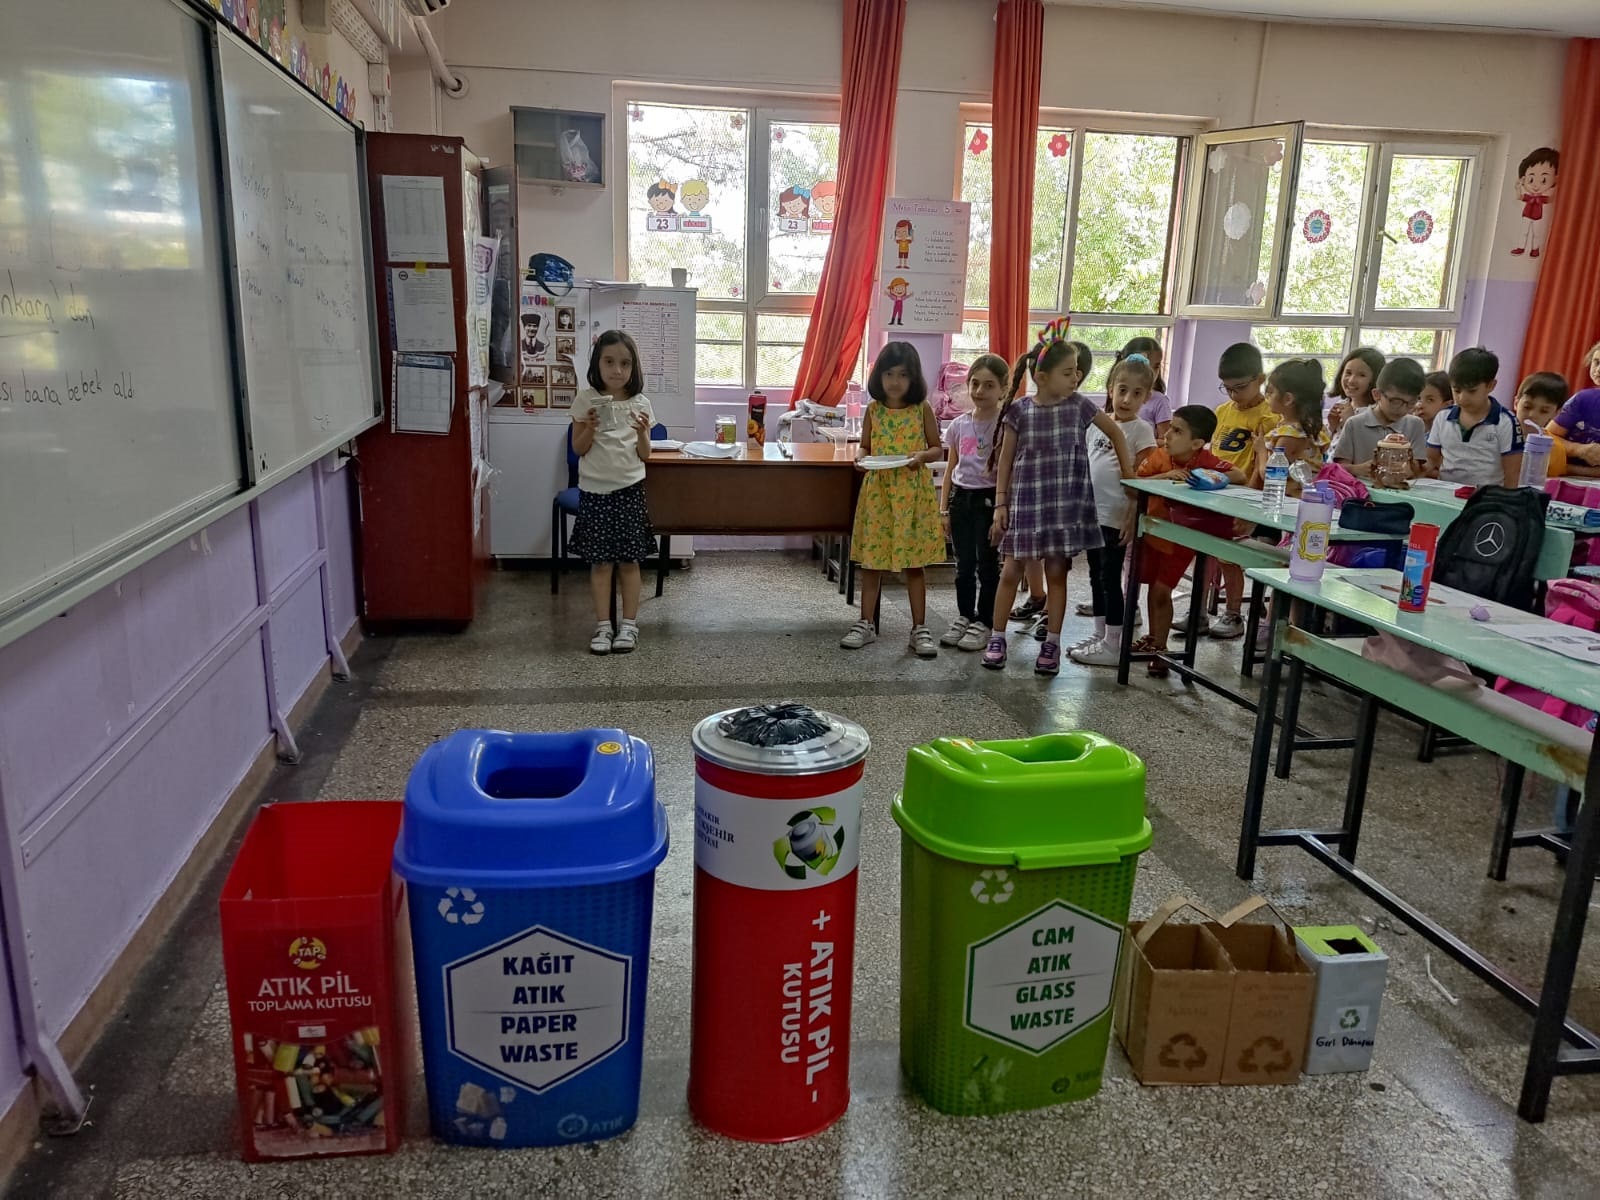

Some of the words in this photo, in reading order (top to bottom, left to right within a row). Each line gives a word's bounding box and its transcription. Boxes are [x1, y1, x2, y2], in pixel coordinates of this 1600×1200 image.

[656, 219, 669, 230] 23
[788, 220, 798, 229] 23
[21, 368, 62, 406] bana
[65, 368, 103, 402] bebek
[1032, 925, 1075, 947] CAM
[298, 946, 321, 957] TAP
[503, 952, 575, 976] KAĞIT
[1027, 953, 1072, 974] ATIK
[258, 977, 314, 997] ATIK
[321, 971, 359, 995] PİL
[809, 941, 834, 1024] ATIK
[1016, 981, 1076, 1004] GLASS
[248, 999, 314, 1012] TOPLAMA
[316, 995, 372, 1010] KUTUSU
[512, 985, 565, 1005] ATIK
[501, 1014, 577, 1034] PAPER
[781, 962, 803, 1064] KUTUSU
[1010, 1008, 1075, 1031] WASTE
[500, 1042, 578, 1063] WASTE
[806, 1026, 833, 1085] PİL
